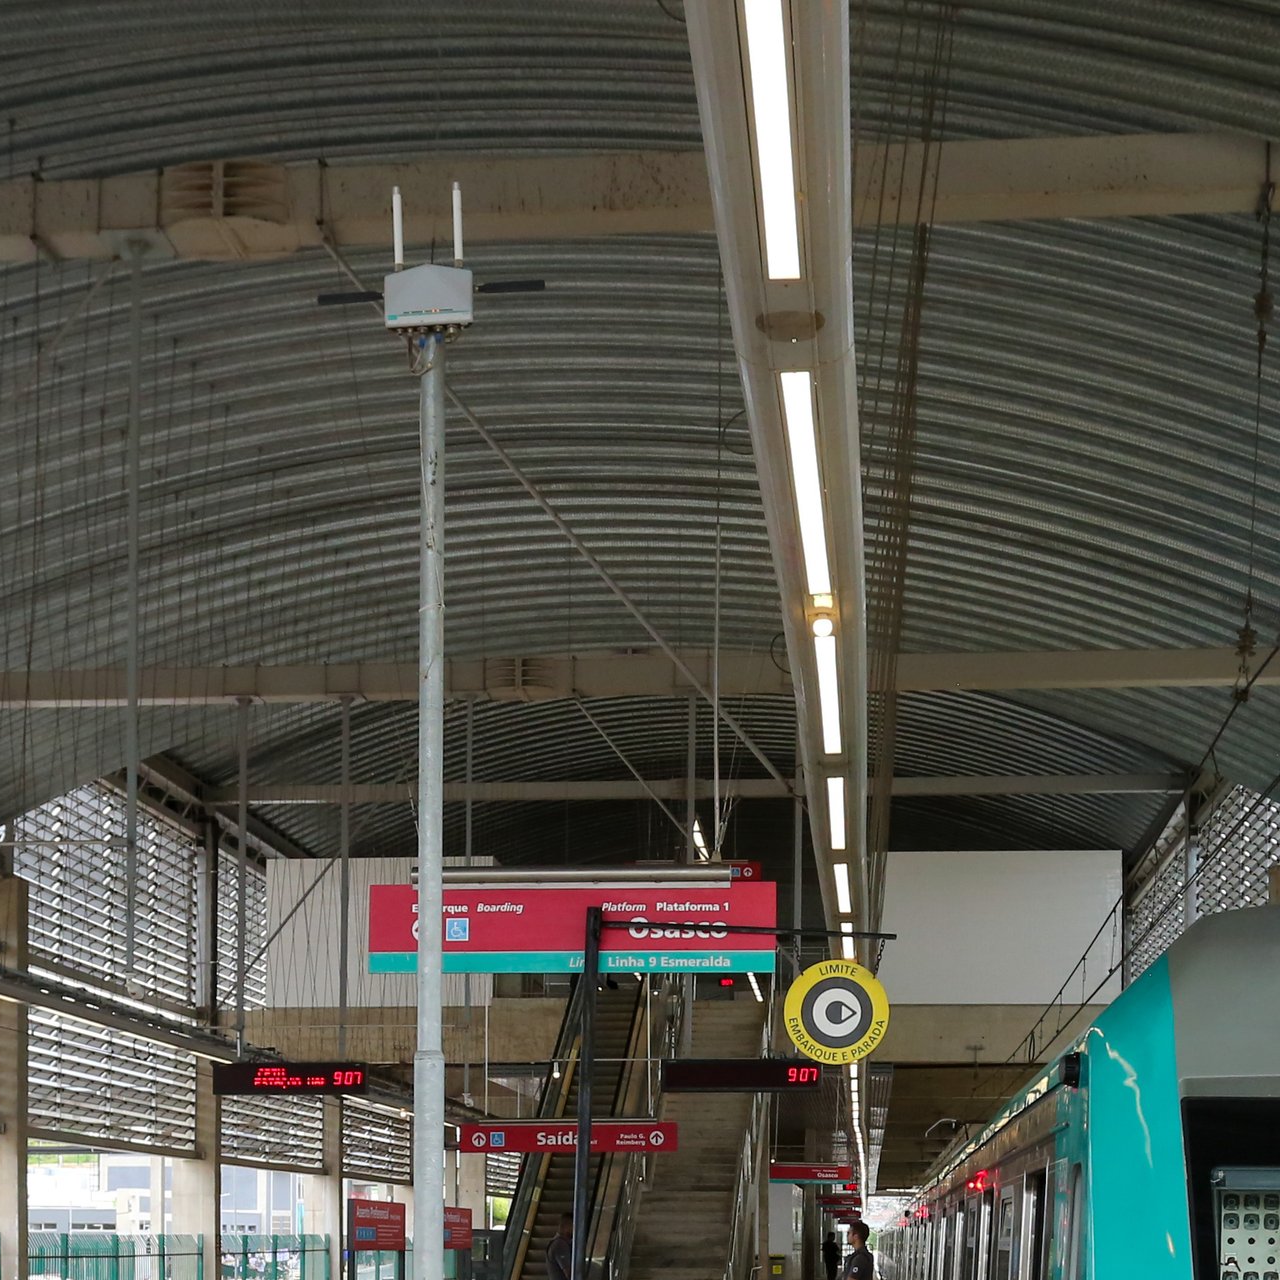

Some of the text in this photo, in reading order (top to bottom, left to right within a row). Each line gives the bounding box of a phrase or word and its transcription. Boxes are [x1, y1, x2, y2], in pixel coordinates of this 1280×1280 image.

[412, 902, 523, 915] Erque Boarding
[602, 902, 729, 912] Platform Plataforma 1
[628, 917, 728, 939] Osasco
[608, 956, 644, 967] Linha
[649, 956, 657, 967] 9
[661, 956, 731, 967] Esmeralda
[819, 964, 858, 976] LIMITE
[789, 1017, 885, 1061] EMBARQUE E PARADA
[788, 1068, 818, 1082] 907
